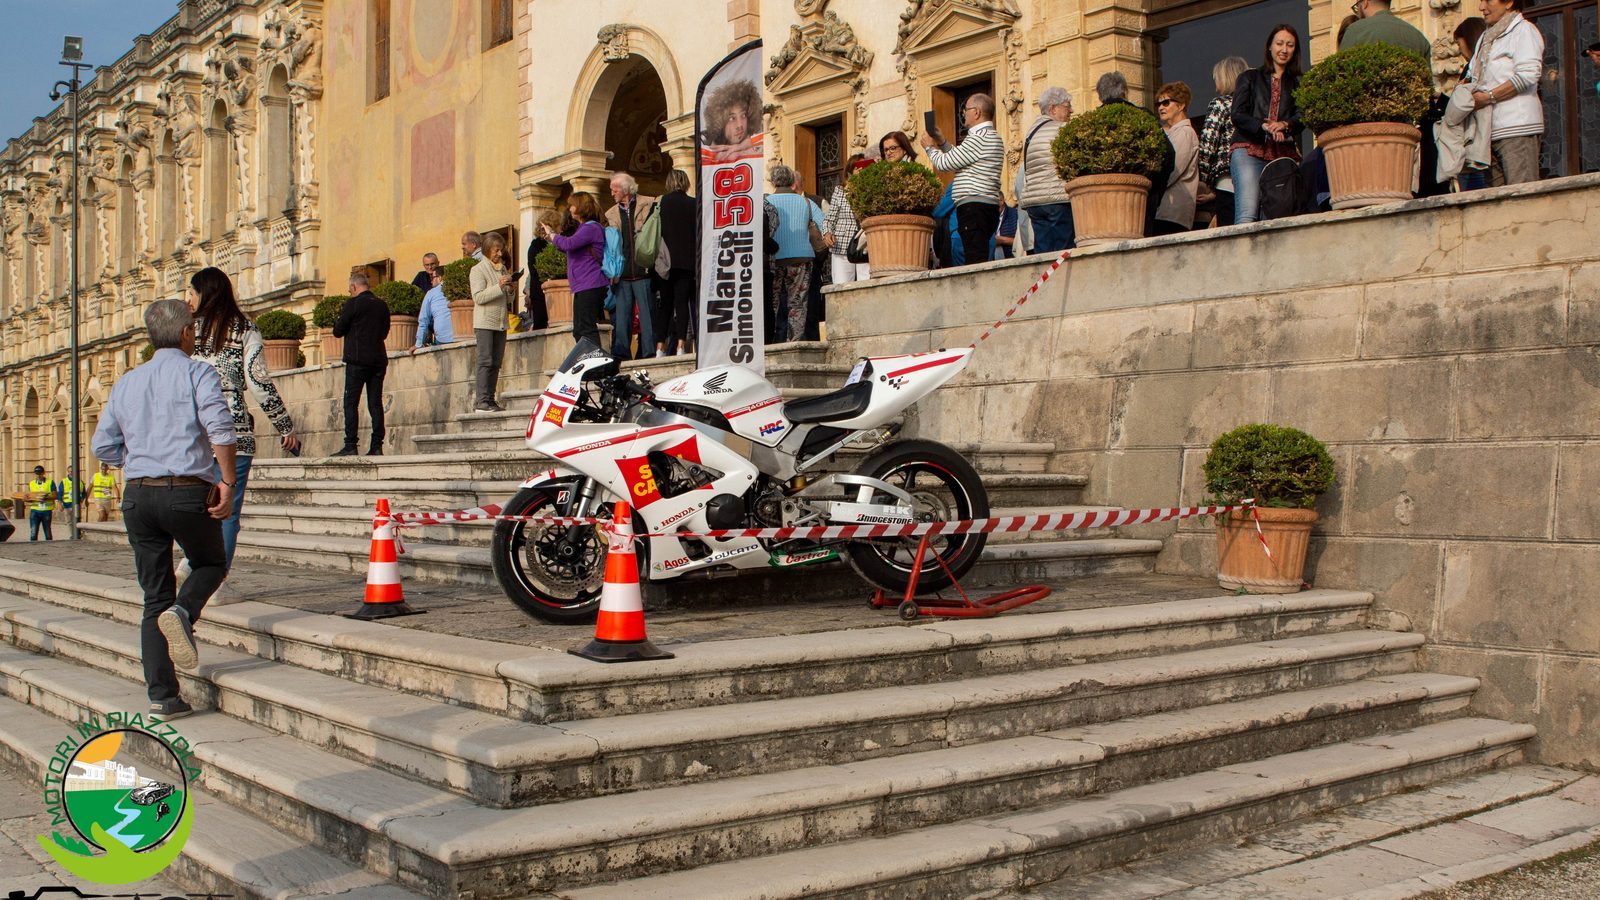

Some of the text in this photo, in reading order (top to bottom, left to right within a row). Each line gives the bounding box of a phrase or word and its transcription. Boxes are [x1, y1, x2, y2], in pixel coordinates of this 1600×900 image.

[713, 163, 754, 229] 58
[707, 230, 736, 333] Marco
[729, 231, 754, 364] Simoncelli
[703, 388, 733, 396] HONDA
[759, 420, 785, 437] HRC
[577, 440, 612, 452] HONDA
[661, 506, 695, 527] HONDA
[856, 513, 913, 525] BRIDGESTONE
[713, 544, 759, 560] DUCATO
[785, 549, 830, 565] Castrol
[664, 556, 690, 569] Agos
